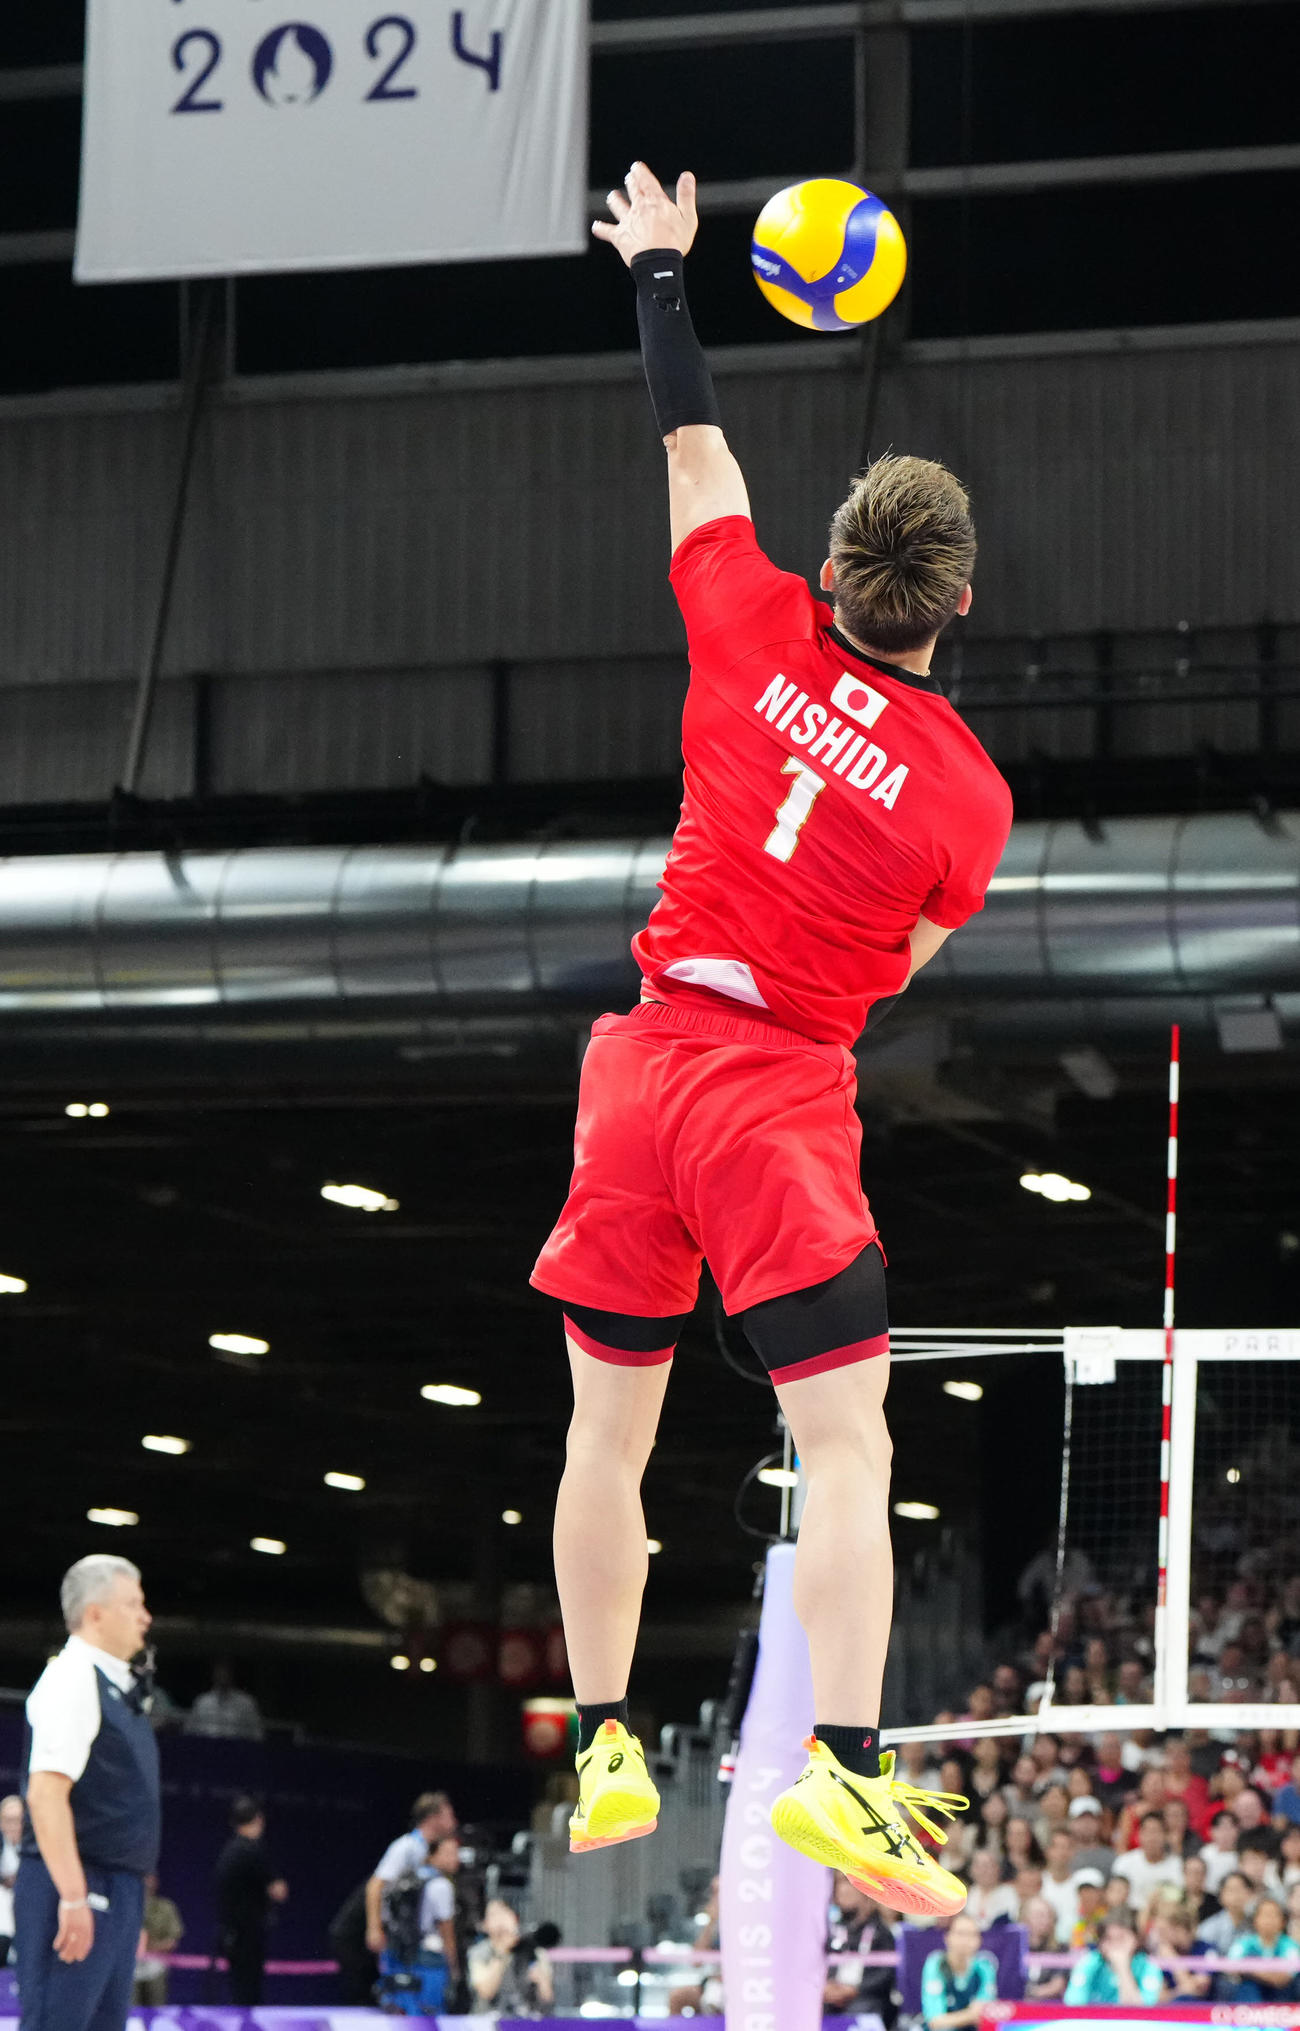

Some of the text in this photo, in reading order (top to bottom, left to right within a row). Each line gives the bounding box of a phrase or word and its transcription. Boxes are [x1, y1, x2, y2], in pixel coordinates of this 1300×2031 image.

[169, 9, 504, 115] 2024
[753, 672, 910, 811] NISHIDA
[762, 754, 827, 864] 1
